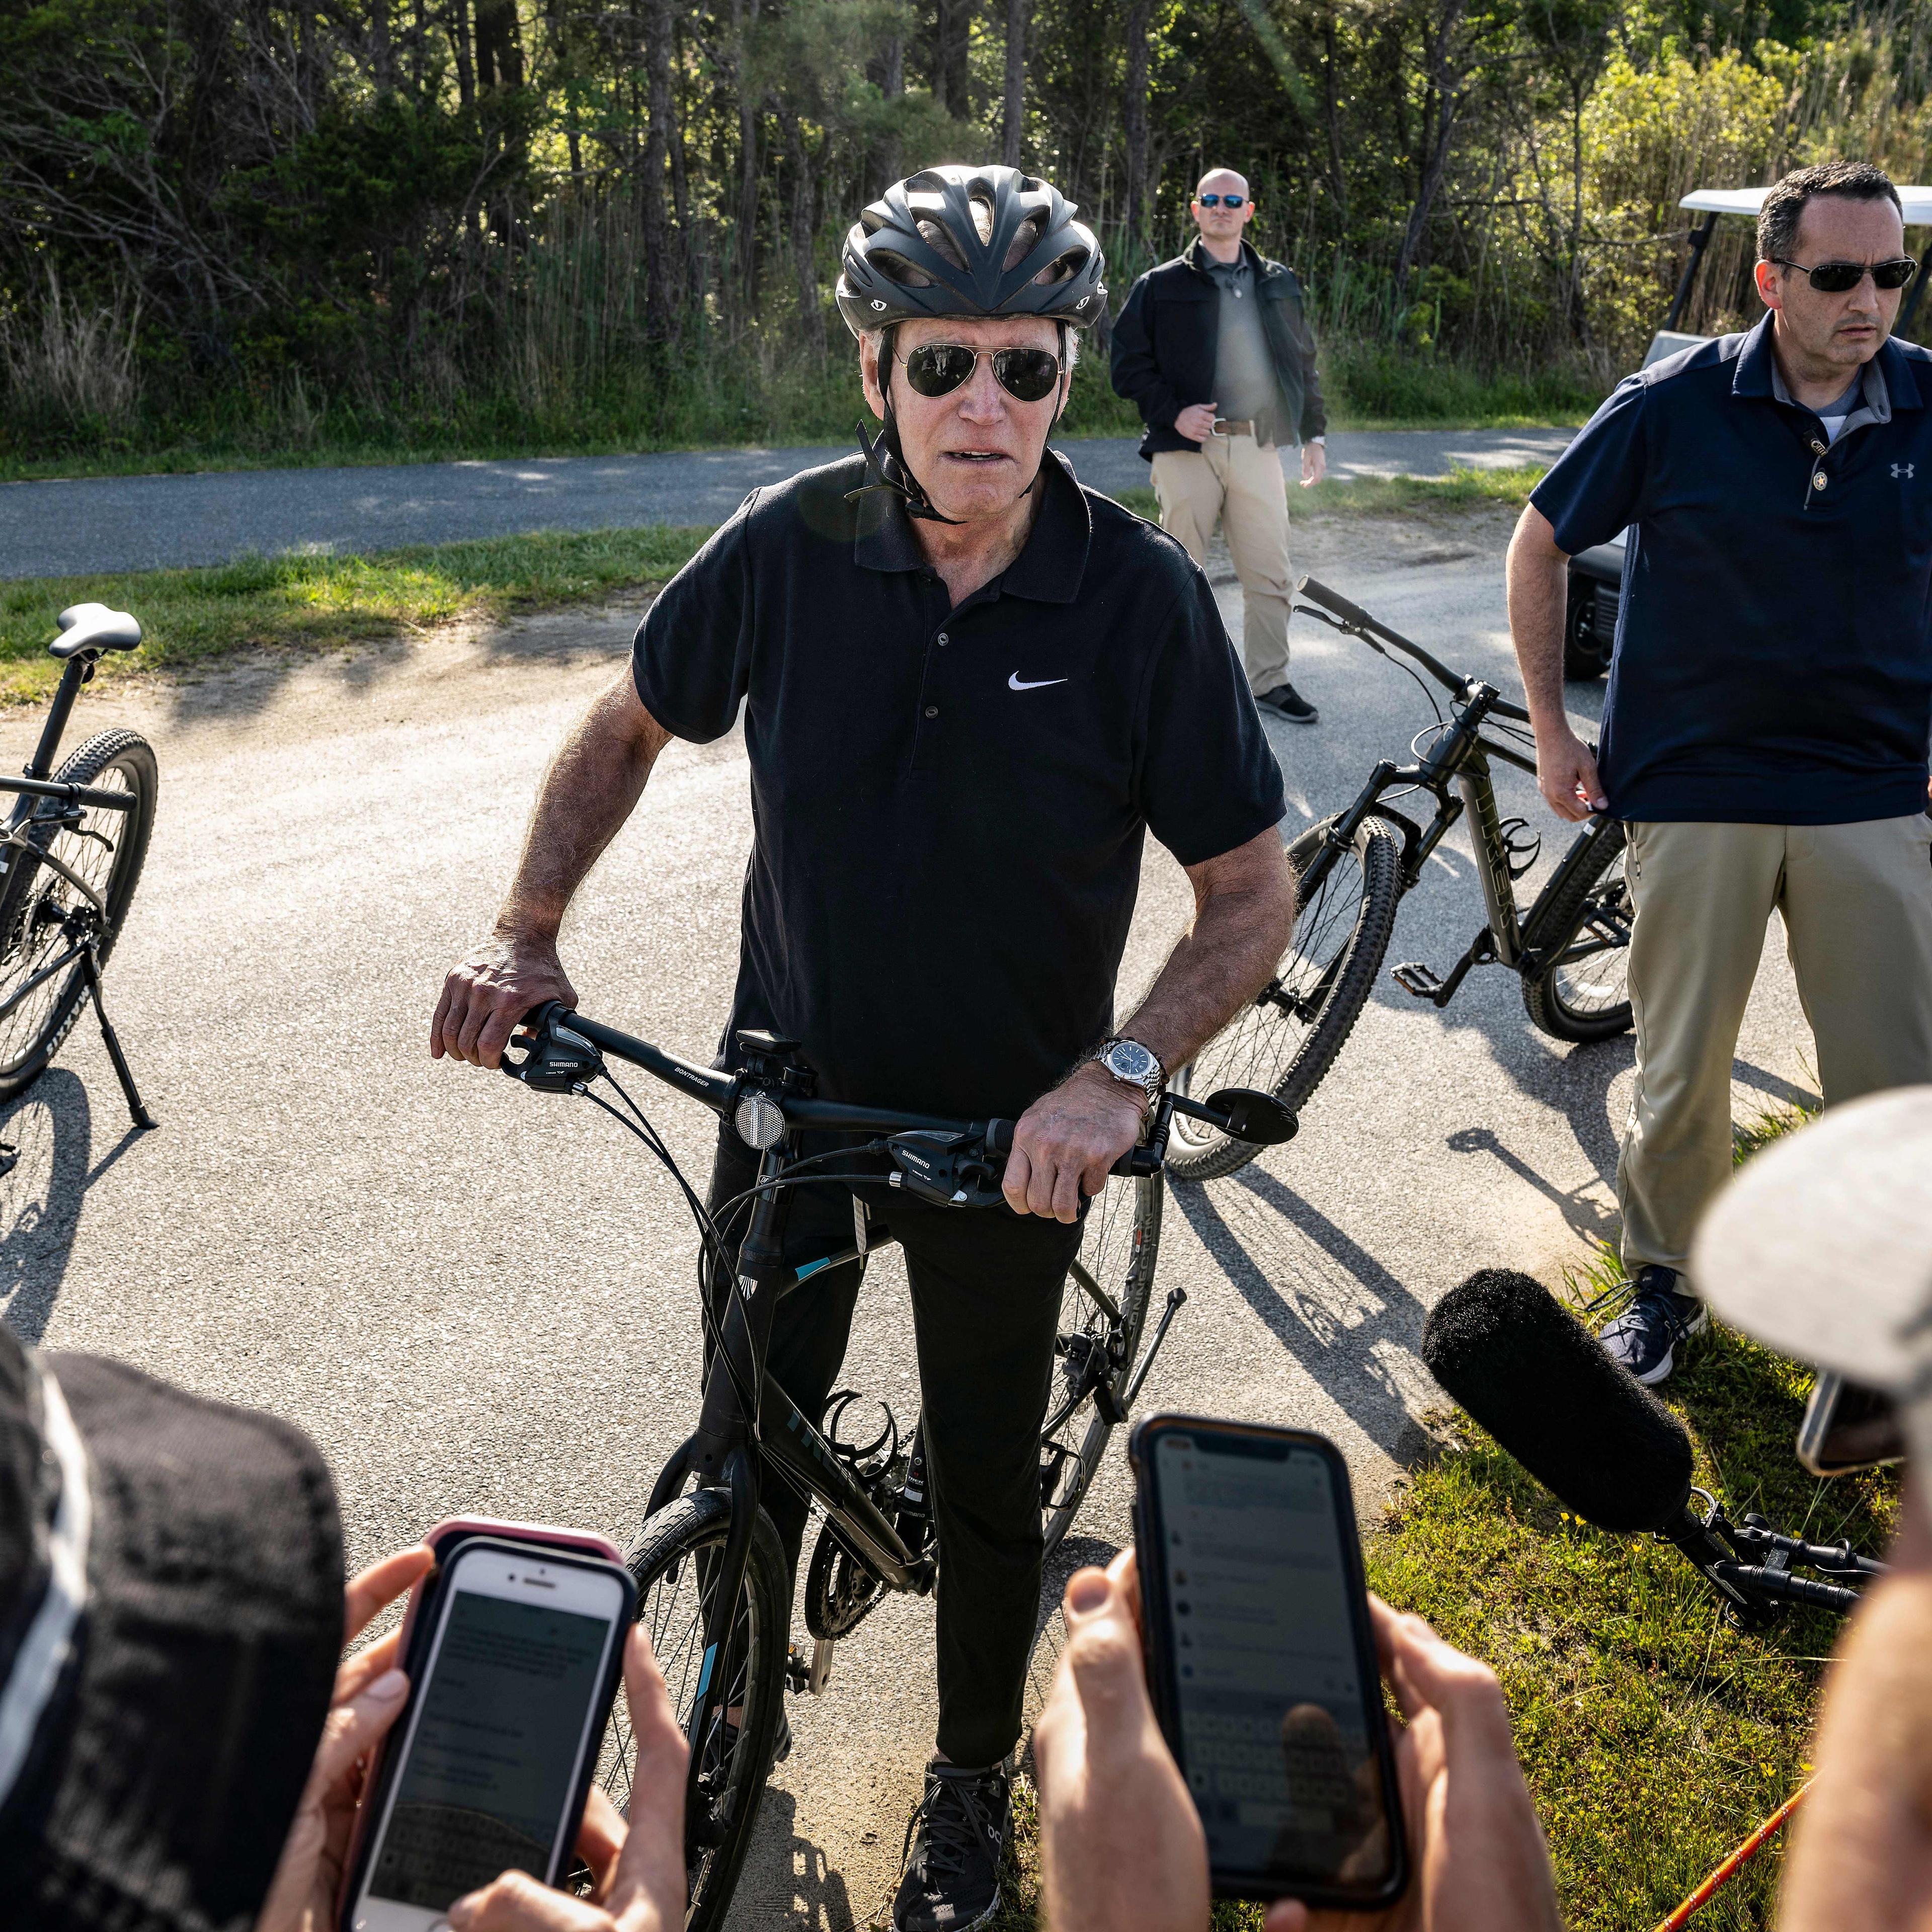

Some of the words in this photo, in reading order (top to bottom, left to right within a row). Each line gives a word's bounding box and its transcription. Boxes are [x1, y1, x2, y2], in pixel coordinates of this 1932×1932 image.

[46, 985, 90, 1056] MAXXIS
[674, 1067, 709, 1087] BONTRAGER
[901, 1150, 930, 1169] SHIMANO
